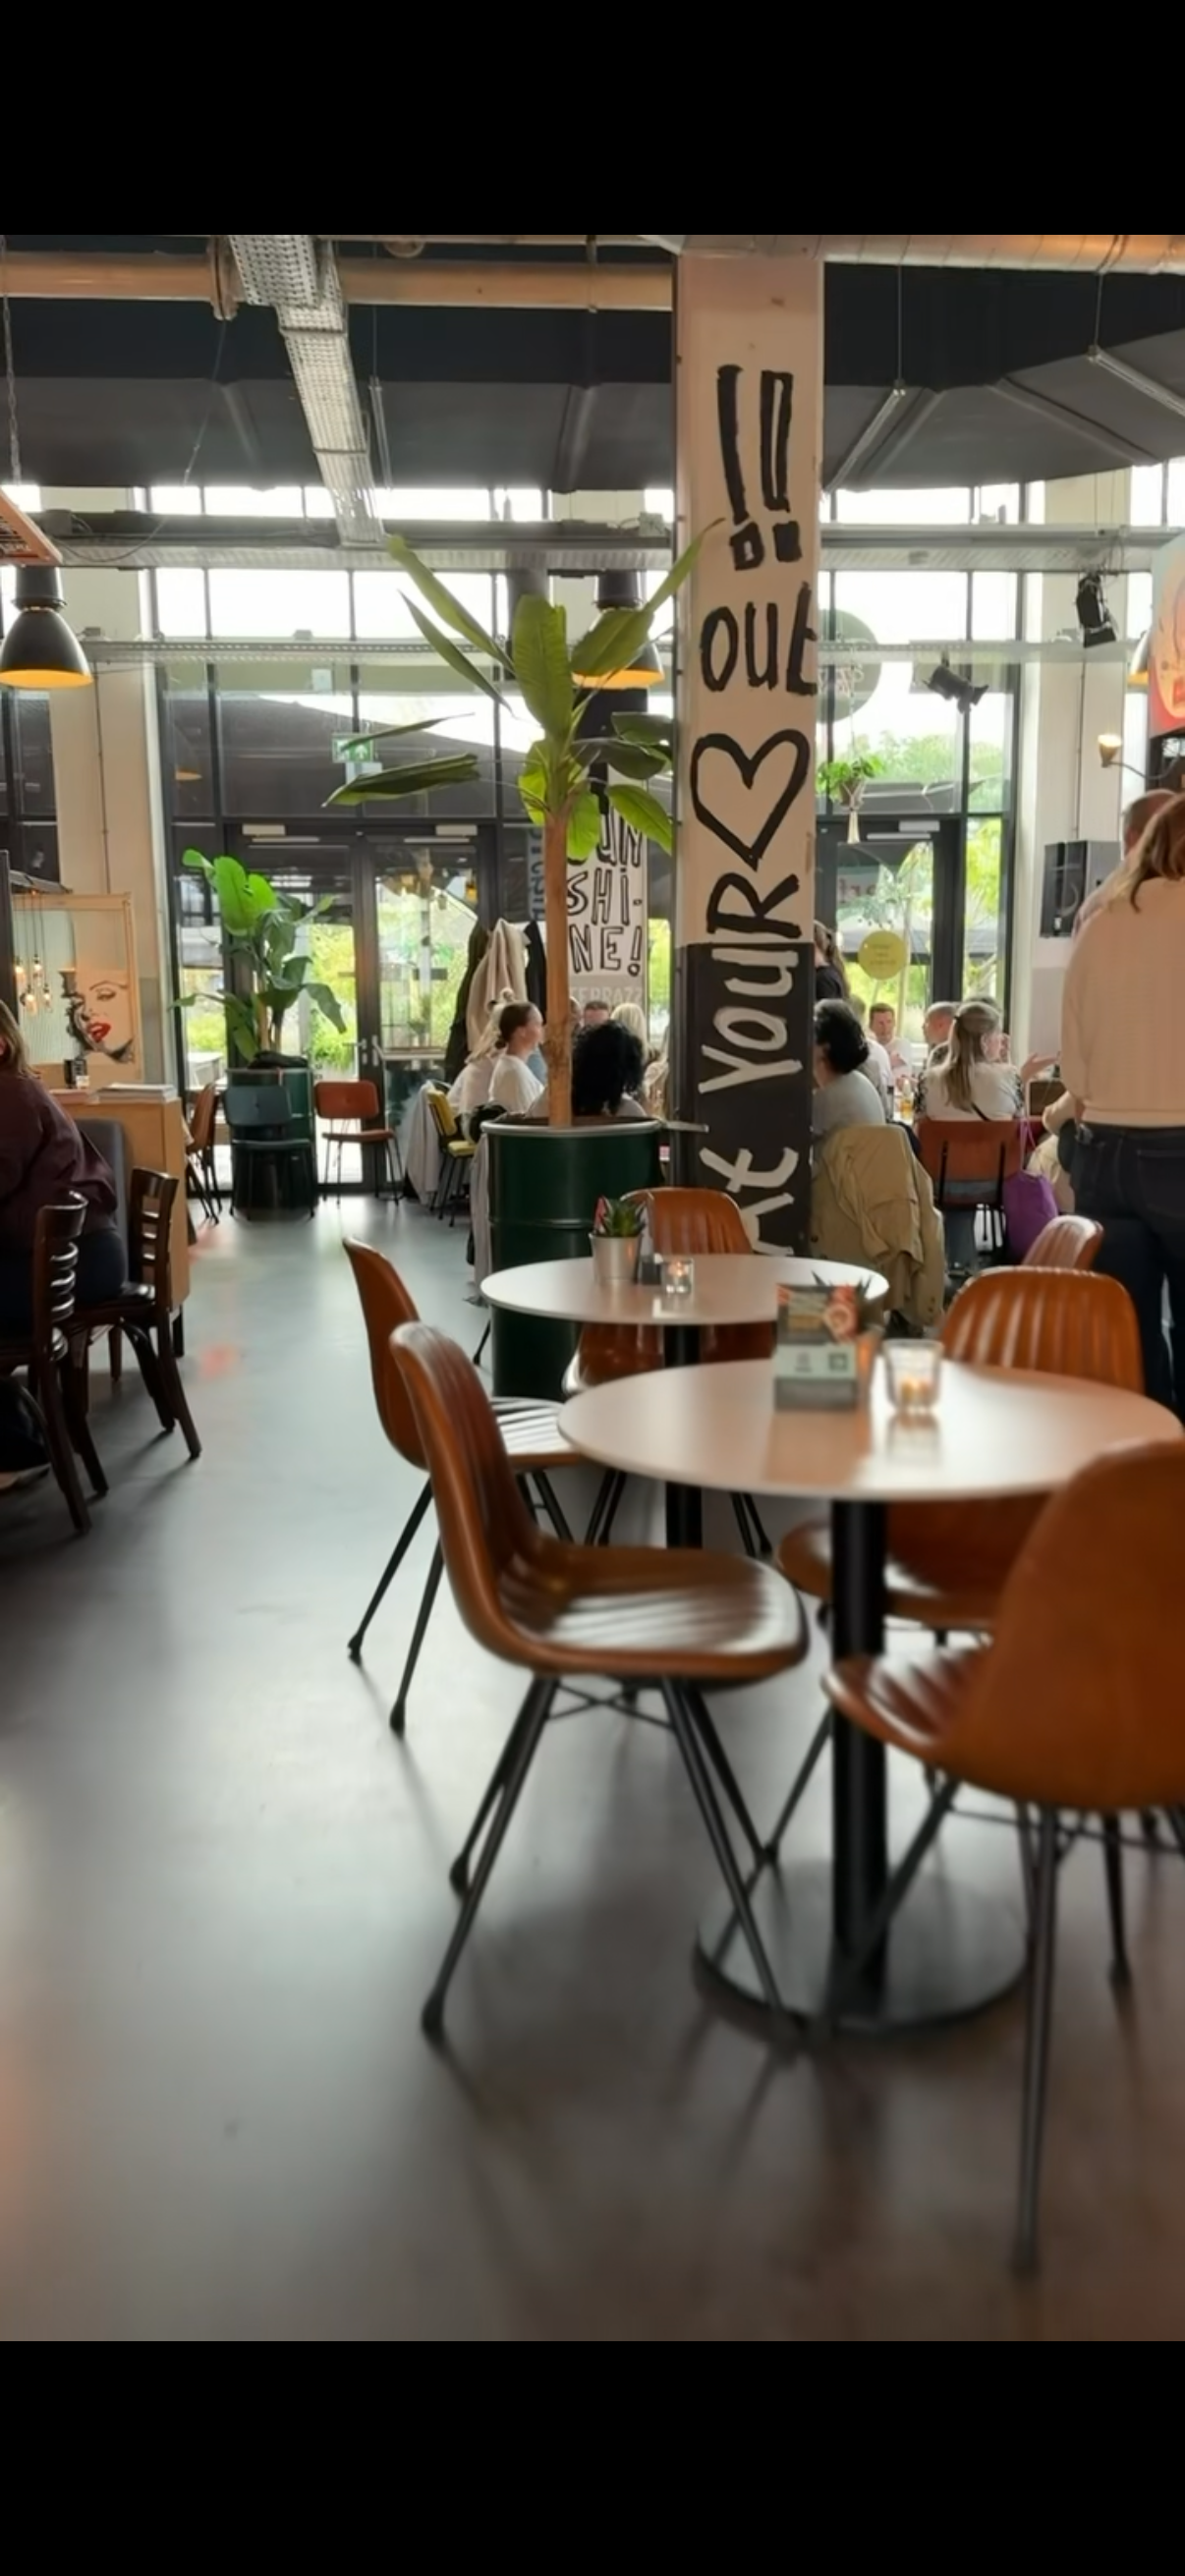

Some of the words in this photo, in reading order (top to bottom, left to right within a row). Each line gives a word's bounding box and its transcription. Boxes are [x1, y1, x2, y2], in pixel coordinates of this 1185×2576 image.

[716, 364, 803, 571] !!
[700, 581, 818, 696] out
[568, 804, 643, 868] UN
[569, 924, 643, 978] NE!
